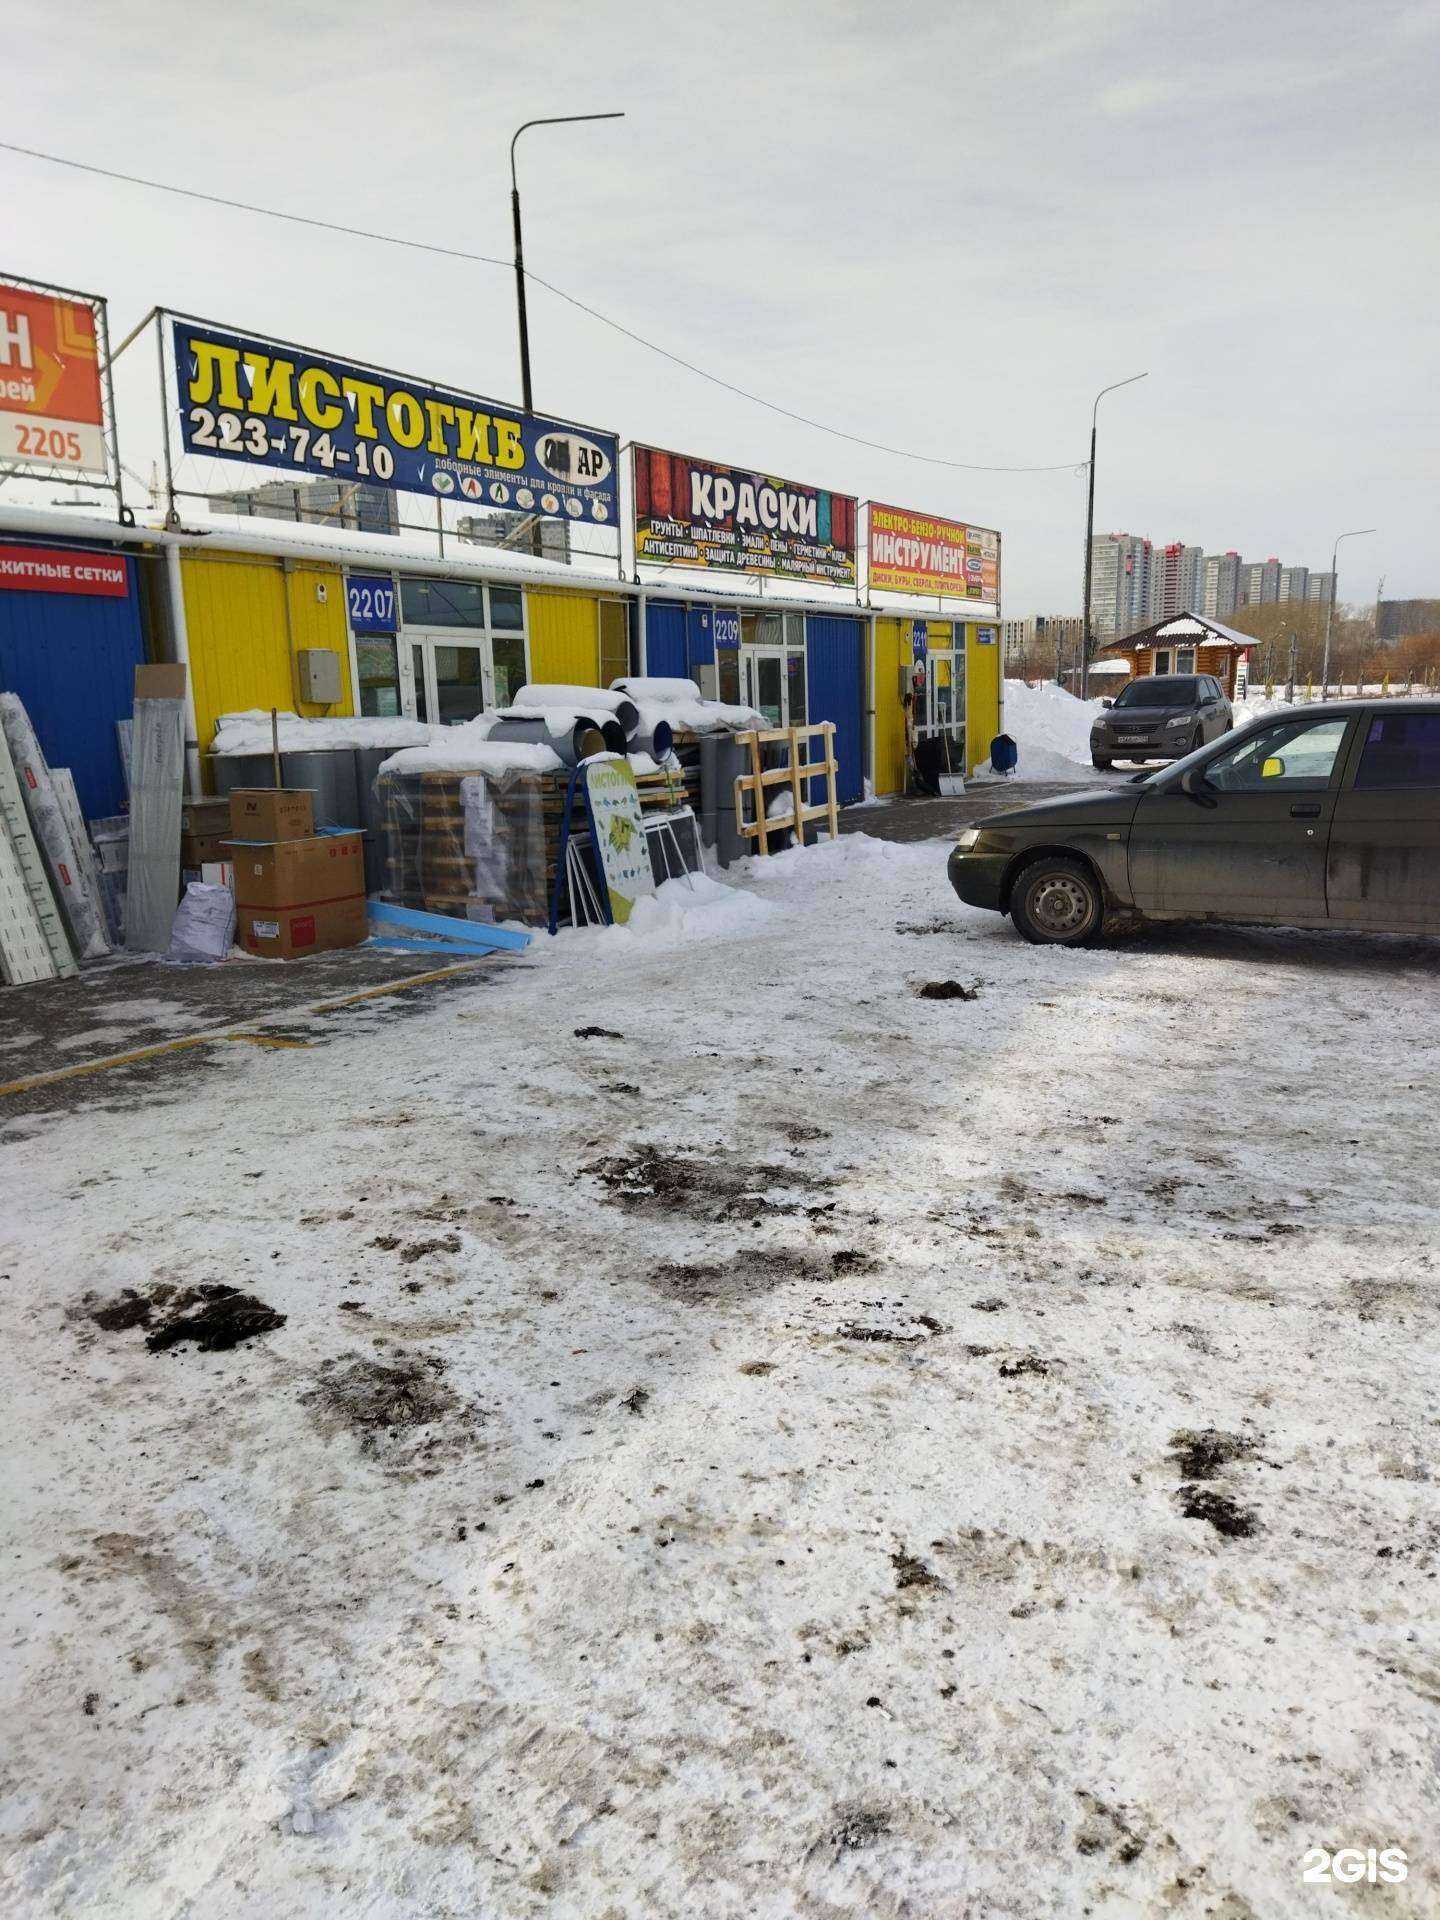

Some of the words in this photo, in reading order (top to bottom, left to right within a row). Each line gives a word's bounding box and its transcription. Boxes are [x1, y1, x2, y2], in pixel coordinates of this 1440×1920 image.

[189, 339, 525, 471] ЛИСТОГИБ
[15, 424, 81, 461] 2205
[190, 408, 394, 480] 223-74-10
[584, 487, 611, 502] фасада
[691, 472, 817, 536] КРАСКИ
[643, 539, 698, 559] АНТИСЕПТИКИ
[705, 547, 735, 563] ЗАЩИТА
[736, 551, 776, 569] ДРЕВЕСИНЫ
[816, 563, 851, 579] ИНСТРУМЕНТ
[650, 520, 684, 538] ГРУНТЫ
[690, 526, 736, 545] ШПАТЛЕВКИ
[742, 534, 764, 549] ЭМАЛИ
[771, 539, 788, 553] ПЕНЫ
[793, 543, 827, 559] ГЕРМЕТИКИ
[872, 532, 965, 574] ИНСТРУМЕНТ
[0, 560, 71, 579] КИТНЫЕ
[74, 566, 123, 583] СЕТКИ
[349, 588, 393, 618] 2207
[715, 620, 738, 641] 2209
